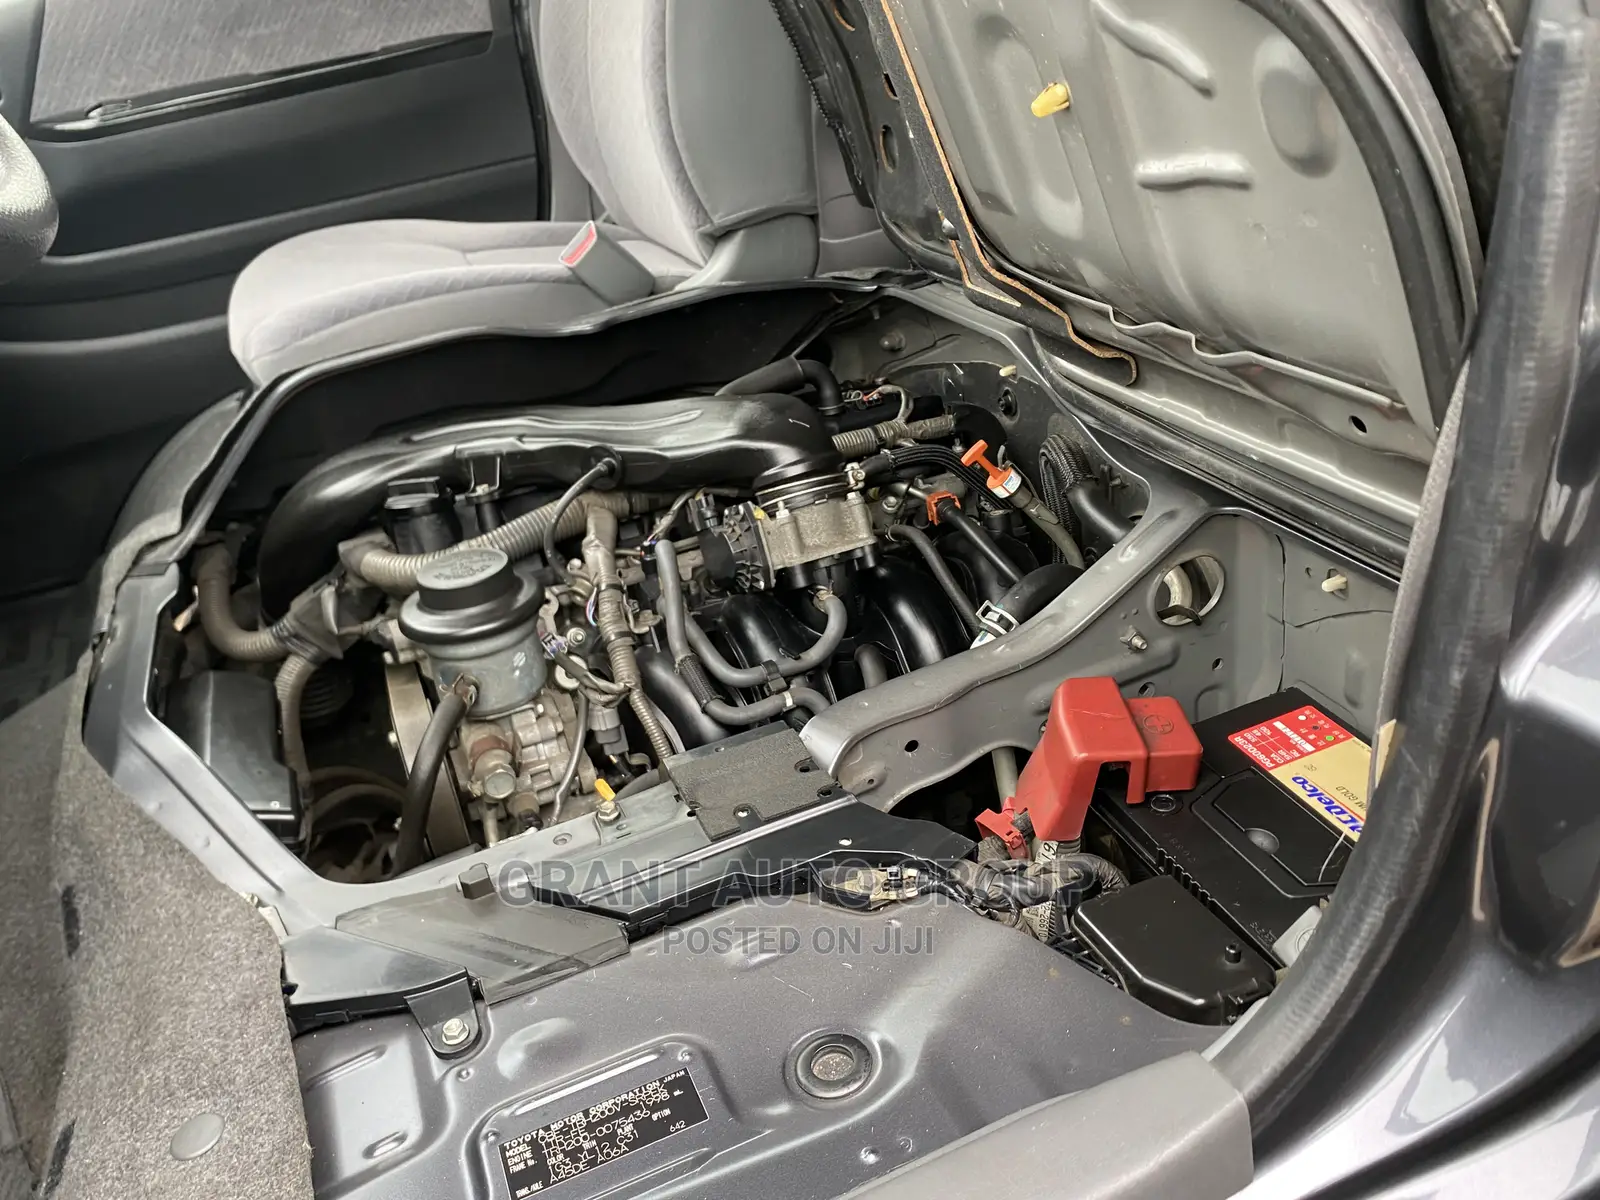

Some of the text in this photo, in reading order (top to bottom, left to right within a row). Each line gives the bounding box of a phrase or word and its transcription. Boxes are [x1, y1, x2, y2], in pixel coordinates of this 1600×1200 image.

[504, 1070, 685, 1150] TOYOTA MOTOR CORPORATION JAPAN
[508, 1150, 533, 1166] ENGINE
[640, 1091, 670, 1110] 1998
[509, 1162, 526, 1174] FRAME
[543, 1107, 651, 1159] TRH200-0075436
[547, 1108, 671, 1166] COLOR TRIM PLANT OPTION
[506, 1143, 531, 1158] MODEL
[548, 1158, 573, 1175] 1G3
[616, 1130, 639, 1146] C31
[549, 1160, 589, 1184] A45DE
[669, 1120, 686, 1132] 642
